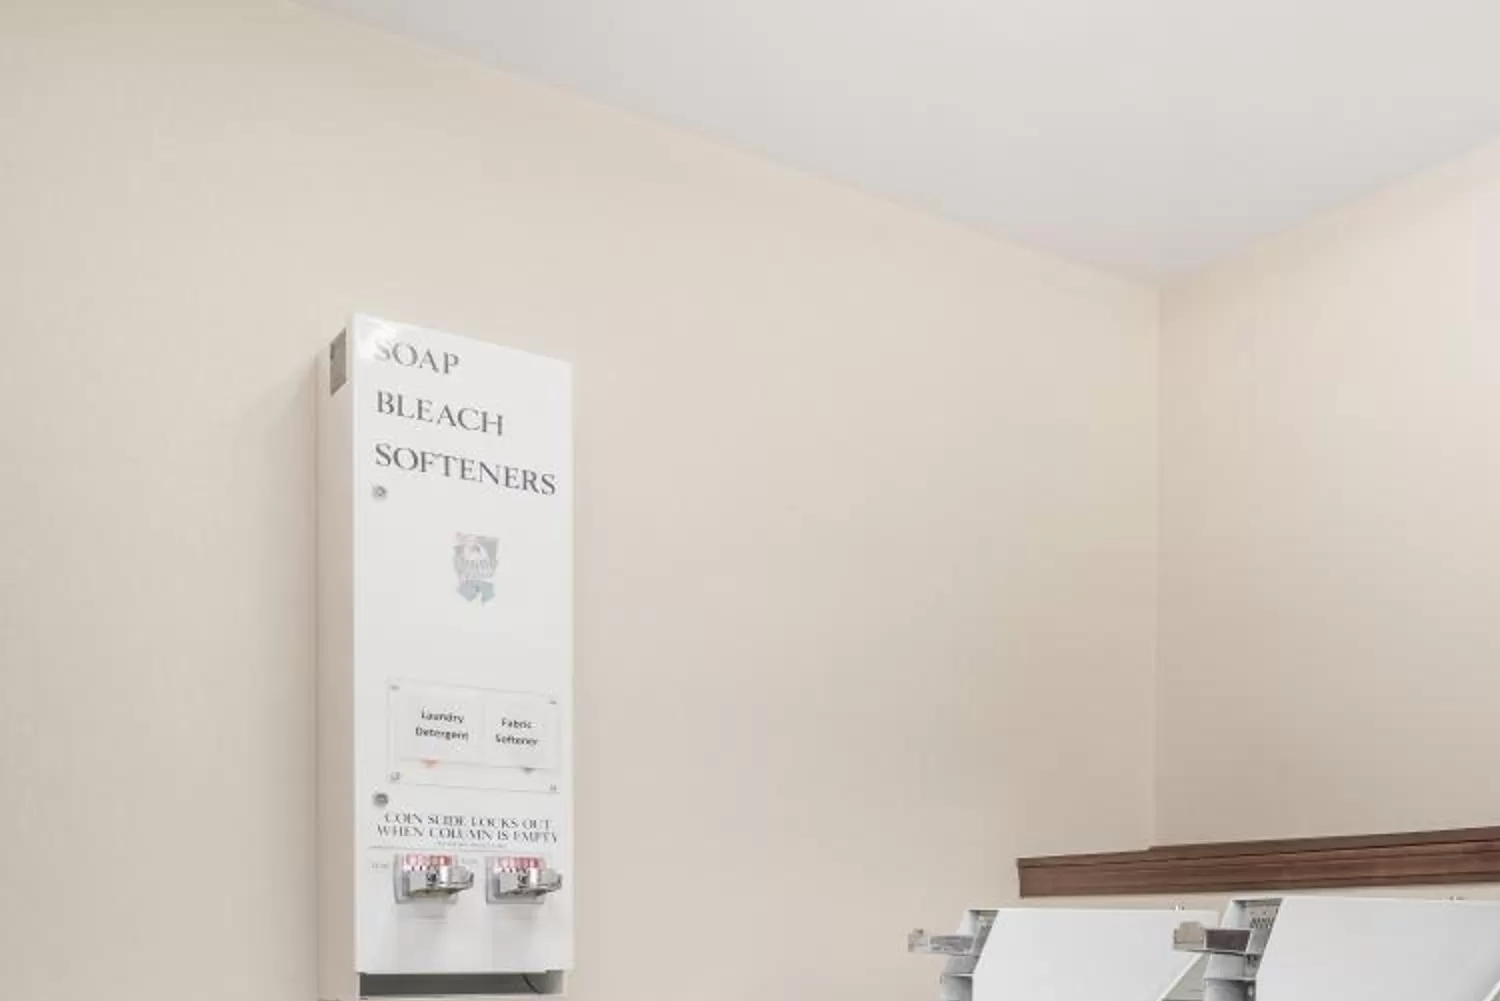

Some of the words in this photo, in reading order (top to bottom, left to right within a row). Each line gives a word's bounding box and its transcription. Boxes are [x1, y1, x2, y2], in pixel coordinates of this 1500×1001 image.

[375, 341, 459, 375] SOAP
[376, 390, 504, 436] BLEACH
[375, 442, 556, 496] SOFTENERS
[421, 708, 464, 724] Laundry
[501, 717, 532, 729] Fabric
[415, 726, 469, 741] Detergent
[495, 733, 538, 746] Softener
[384, 813, 423, 825] COIN
[427, 815, 465, 827] SLIDE
[471, 817, 518, 829] LOCKS
[522, 819, 551, 831] OUT
[377, 824, 423, 837] WHEN
[429, 827, 492, 841] COLUMN
[497, 831, 508, 841] IS
[513, 831, 557, 843] EMPTY
